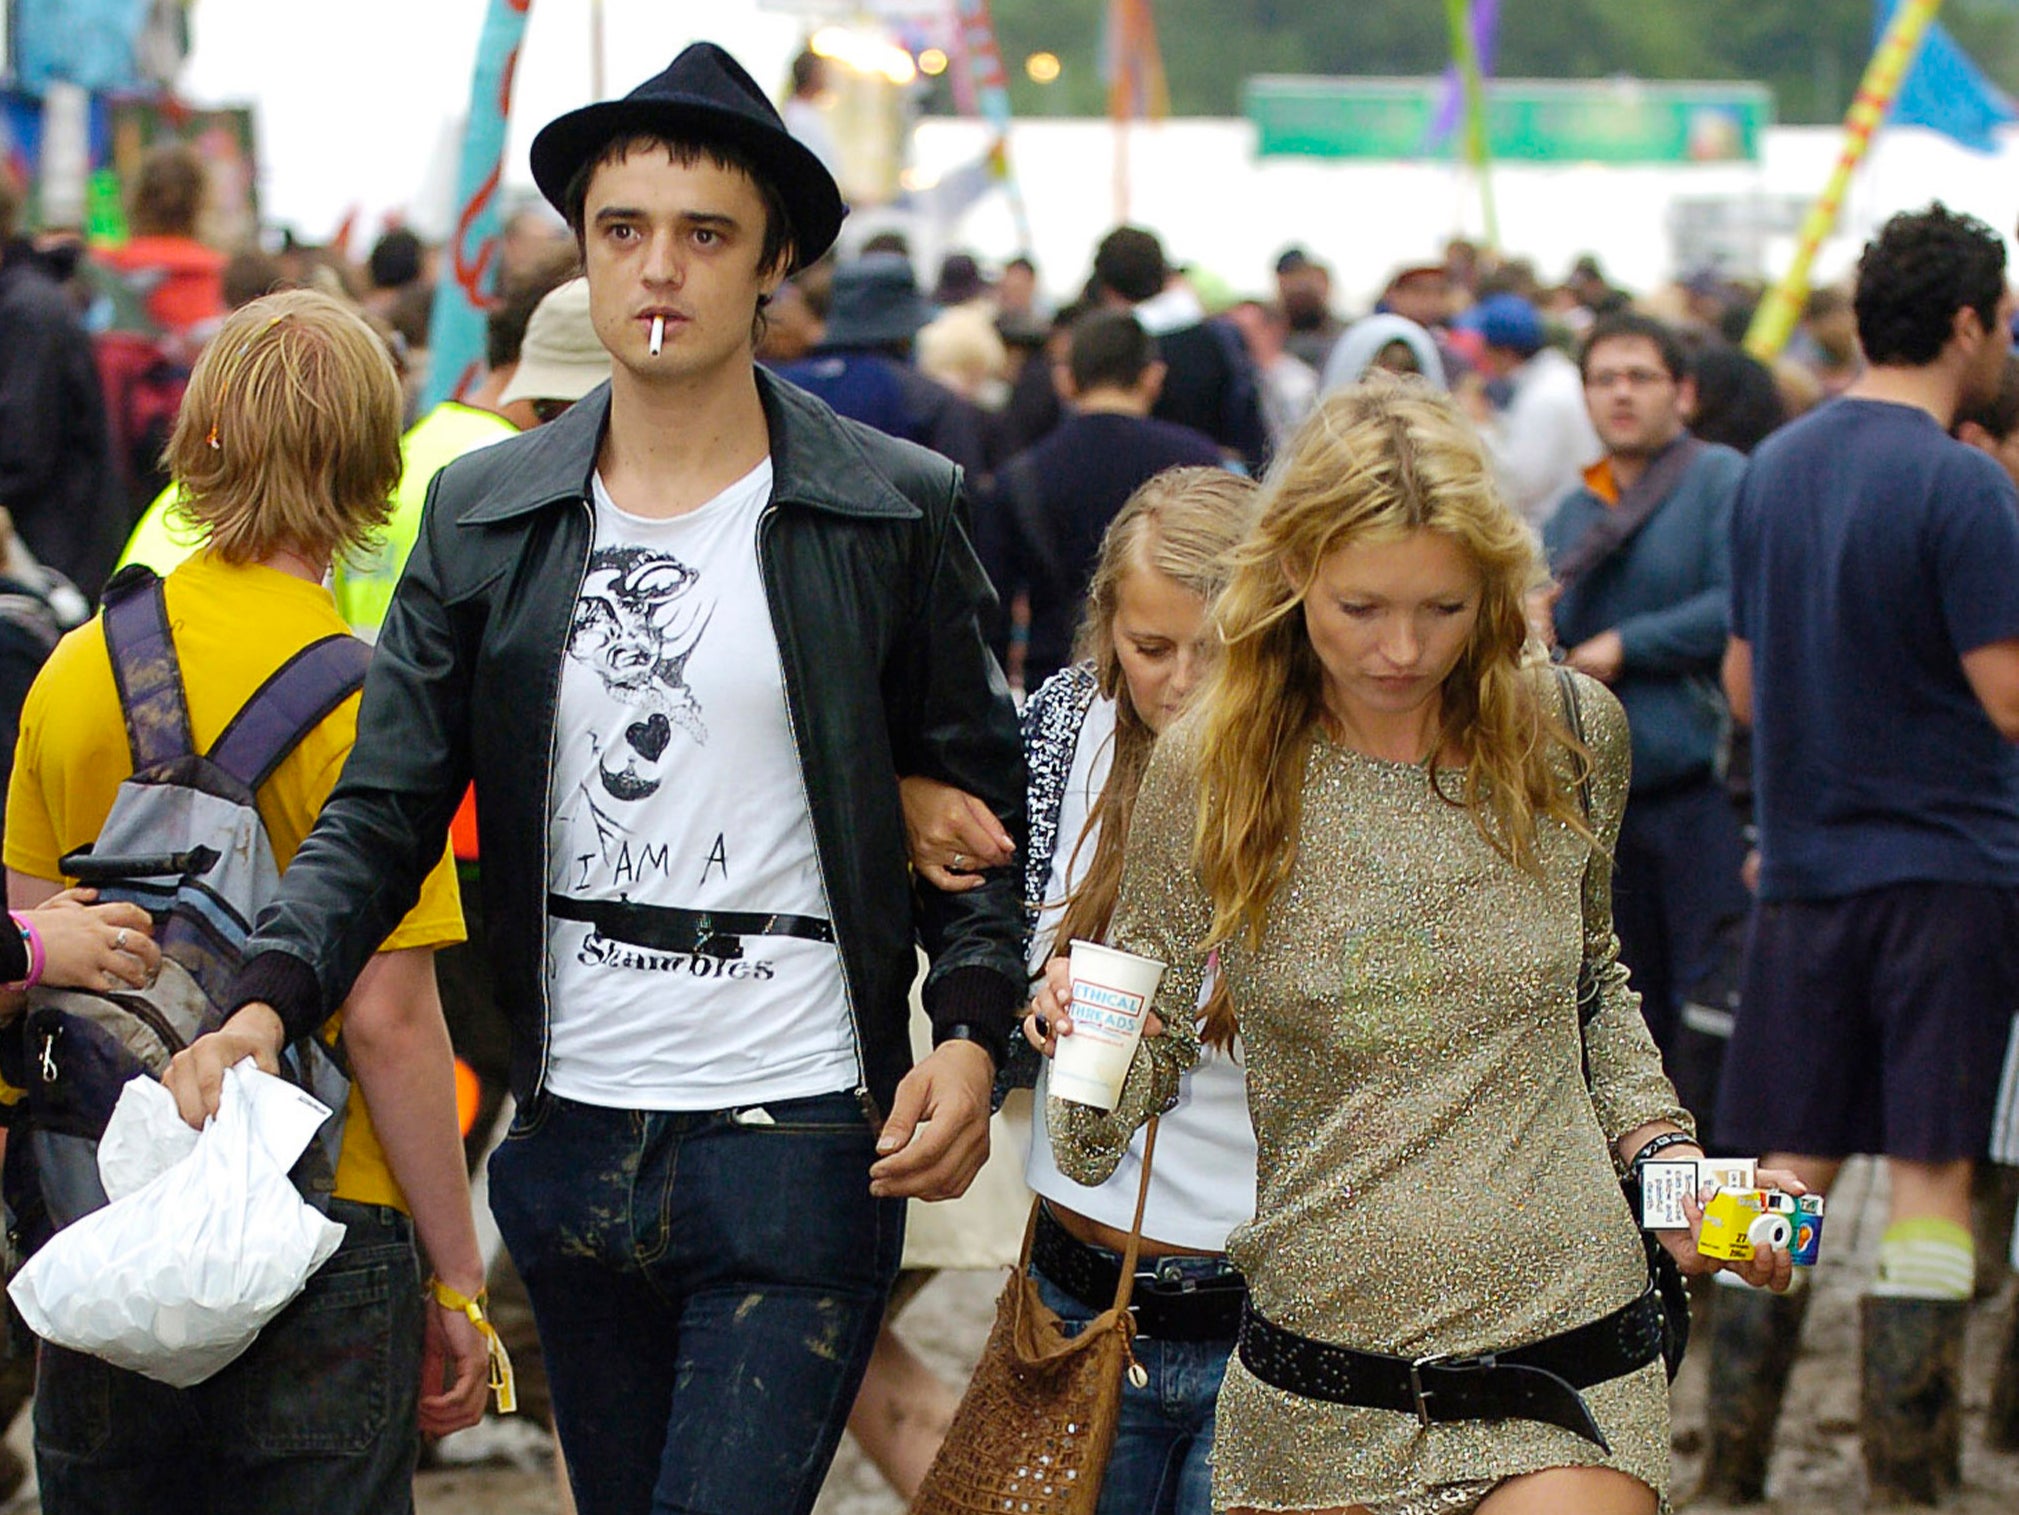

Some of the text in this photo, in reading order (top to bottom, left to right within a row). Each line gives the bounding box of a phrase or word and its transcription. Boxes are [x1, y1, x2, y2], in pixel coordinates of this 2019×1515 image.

[575, 831, 729, 891] I AM A
[1074, 983, 1138, 1012] ETHICAL
[1070, 1003, 1136, 1031] THREADS
